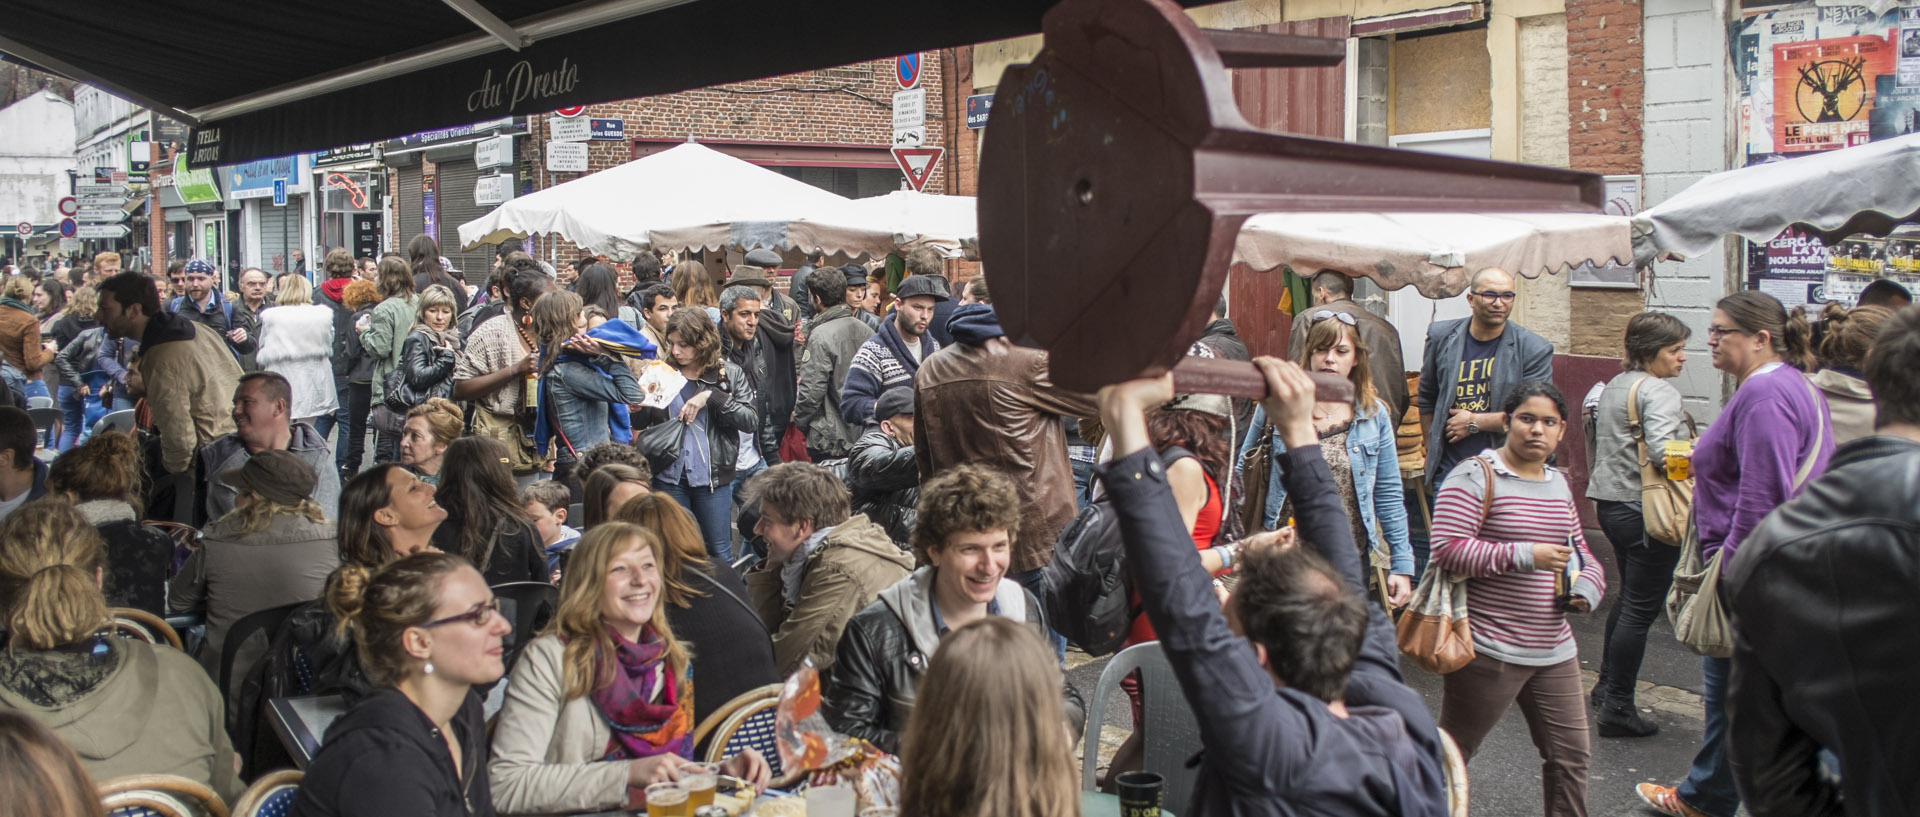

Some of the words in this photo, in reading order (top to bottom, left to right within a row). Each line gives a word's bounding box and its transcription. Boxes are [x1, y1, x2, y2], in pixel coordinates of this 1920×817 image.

[467, 69, 502, 112] Au
[506, 57, 579, 112] Presto
[968, 115, 976, 123] des
[196, 127, 221, 146] STELLA
[1785, 126, 1800, 137] LE
[1785, 137, 1814, 145] EST-IL
[191, 146, 219, 163] ARTOIS
[1792, 247, 1810, 255] LA
[1769, 254, 1826, 265] NOUS-MÊM
